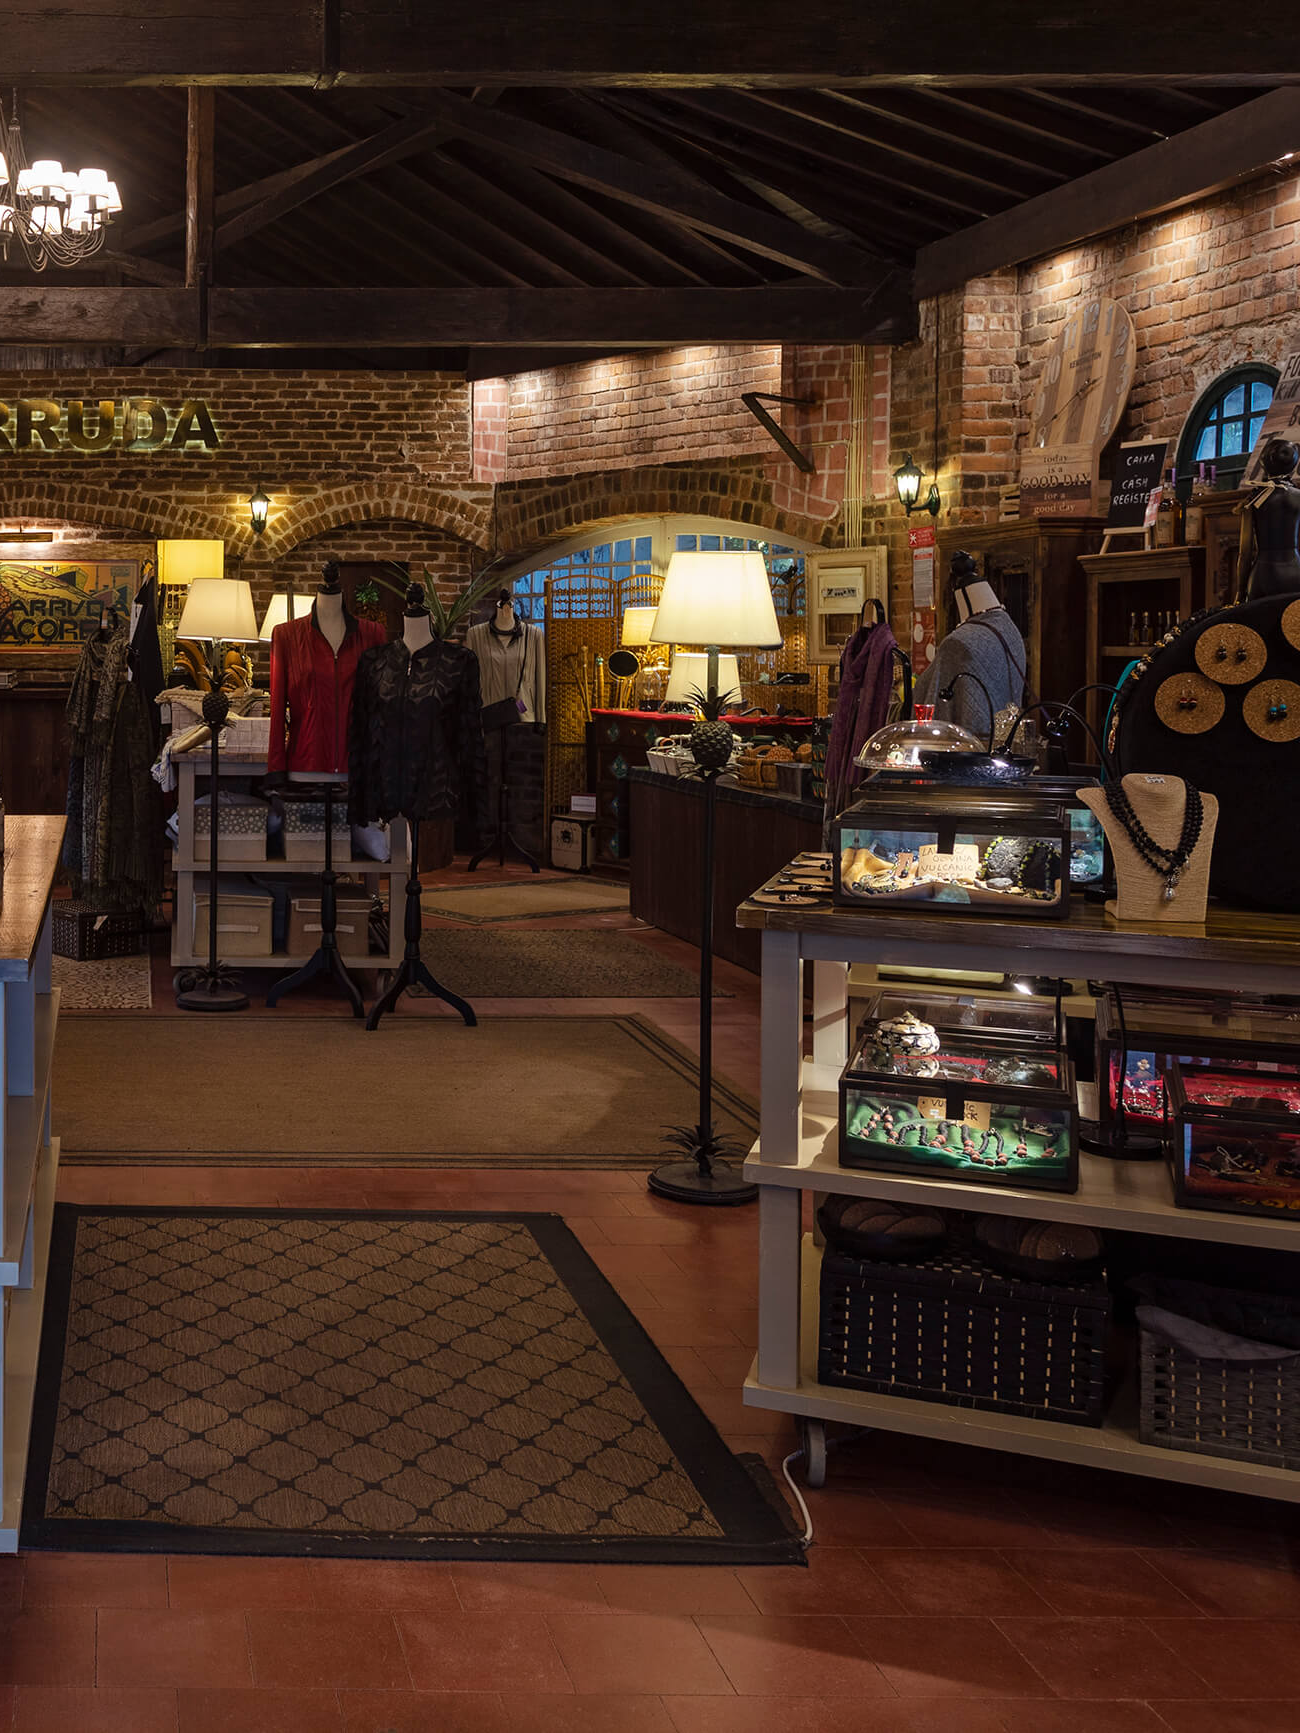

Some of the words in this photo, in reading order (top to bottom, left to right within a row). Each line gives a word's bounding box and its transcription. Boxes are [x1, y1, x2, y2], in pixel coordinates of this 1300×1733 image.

[1084, 303, 1099, 334] 12
[1105, 304, 1114, 336] 1
[1062, 320, 1078, 352] 11
[1114, 325, 1128, 358] 2
[1100, 405, 1113, 435] 4
[1043, 454, 1068, 464] today
[1126, 453, 1155, 466] CAIXA
[1021, 475, 1058, 489] GOOD
[1064, 472, 1089, 487] DAY
[1122, 478, 1148, 490] CASH
[1044, 492, 1058, 500] for
[1113, 492, 1149, 506] REGISTE
[1034, 503, 1057, 515] good
[1060, 501, 1076, 512] day
